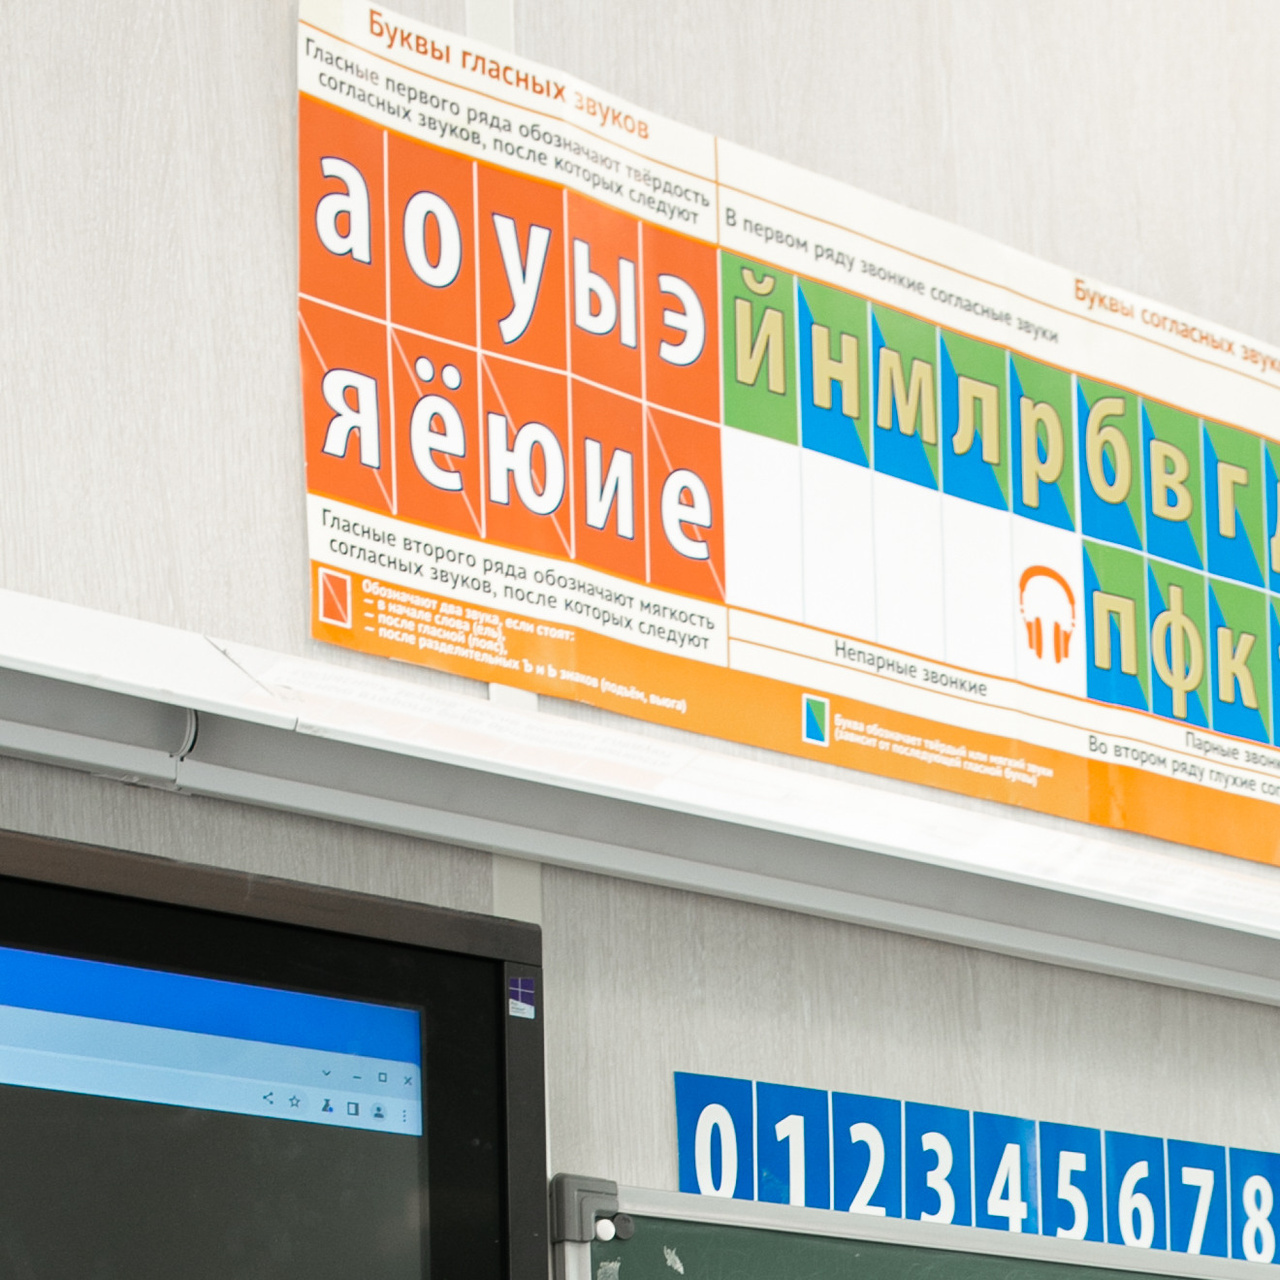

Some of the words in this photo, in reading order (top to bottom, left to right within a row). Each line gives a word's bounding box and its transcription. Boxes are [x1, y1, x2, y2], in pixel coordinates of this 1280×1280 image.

[305, 37, 379, 86] Гласные
[385, 76, 460, 117] первого
[467, 105, 512, 133] ряда
[519, 120, 621, 173] обозначают
[625, 160, 711, 208] твёрдость
[369, 9, 450, 63] Буквы
[461, 51, 566, 102] гласных
[574, 91, 650, 140] звуков
[318, 70, 413, 123] согласных
[419, 112, 488, 151] звуков,
[494, 136, 548, 167] после
[554, 156, 624, 198] которых
[629, 186, 699, 225] следуют
[315, 155, 372, 265] а
[403, 190, 463, 289] о
[491, 212, 552, 344] у
[573, 237, 637, 349] ы
[657, 273, 706, 367] э
[725, 208, 738, 228] В
[742, 216, 808, 254] первом
[815, 243, 854, 272] ряду
[860, 257, 926, 295] звонкие
[930, 281, 1012, 327] согласные
[1017, 313, 1059, 345] звуки
[1074, 278, 1133, 320] Буквы
[1141, 305, 1234, 356] согласных
[321, 367, 381, 470] я
[409, 356, 467, 492] ё
[487, 412, 566, 516] ю
[584, 437, 634, 540] и
[661, 468, 712, 561] е
[733, 267, 786, 395] й
[810, 323, 860, 419] н
[876, 346, 937, 445] м
[952, 374, 1000, 466] л
[1018, 394, 1064, 508] р
[1084, 397, 1132, 505] б
[1149, 438, 1193, 522] в
[1216, 460, 1249, 538] г
[322, 508, 397, 549] Гласные
[403, 537, 476, 570] второго
[484, 558, 527, 584] ряда
[534, 567, 634, 608] обозначают
[639, 598, 715, 630] мягкость
[329, 537, 424, 576] согласных
[430, 564, 498, 598] звуков,
[503, 583, 557, 609] после
[564, 598, 632, 631] которых
[638, 619, 710, 650] следуют
[362, 579, 437, 610] Обозначают
[439, 602, 462, 616] два
[505, 618, 534, 633] если
[378, 614, 415, 631] после
[418, 623, 466, 643] гласной
[388, 602, 432, 622] начале
[435, 614, 470, 632] слова
[379, 627, 416, 645] после
[419, 636, 519, 670] разделительных
[536, 664, 545, 675] и
[560, 669, 599, 688] знаков
[834, 640, 917, 681] Непарные
[923, 664, 987, 697] звонкие
[1092, 590, 1137, 676] п
[1150, 584, 1204, 719] ф
[1217, 625, 1259, 711] к
[1088, 734, 1107, 754] Во
[1114, 744, 1166, 769] втором
[1172, 758, 1205, 781] ряду
[1209, 770, 1256, 791] глухие
[1185, 731, 1238, 761] Парные
[695, 1103, 738, 1200] 0
[774, 1114, 805, 1206] 1
[849, 1122, 886, 1215] 2
[920, 1131, 955, 1224] 3
[987, 1143, 1026, 1233] 4
[1056, 1151, 1088, 1241] 5
[1119, 1161, 1154, 1249] 6
[1181, 1167, 1215, 1255] 7
[1243, 1175, 1275, 1263] 8
